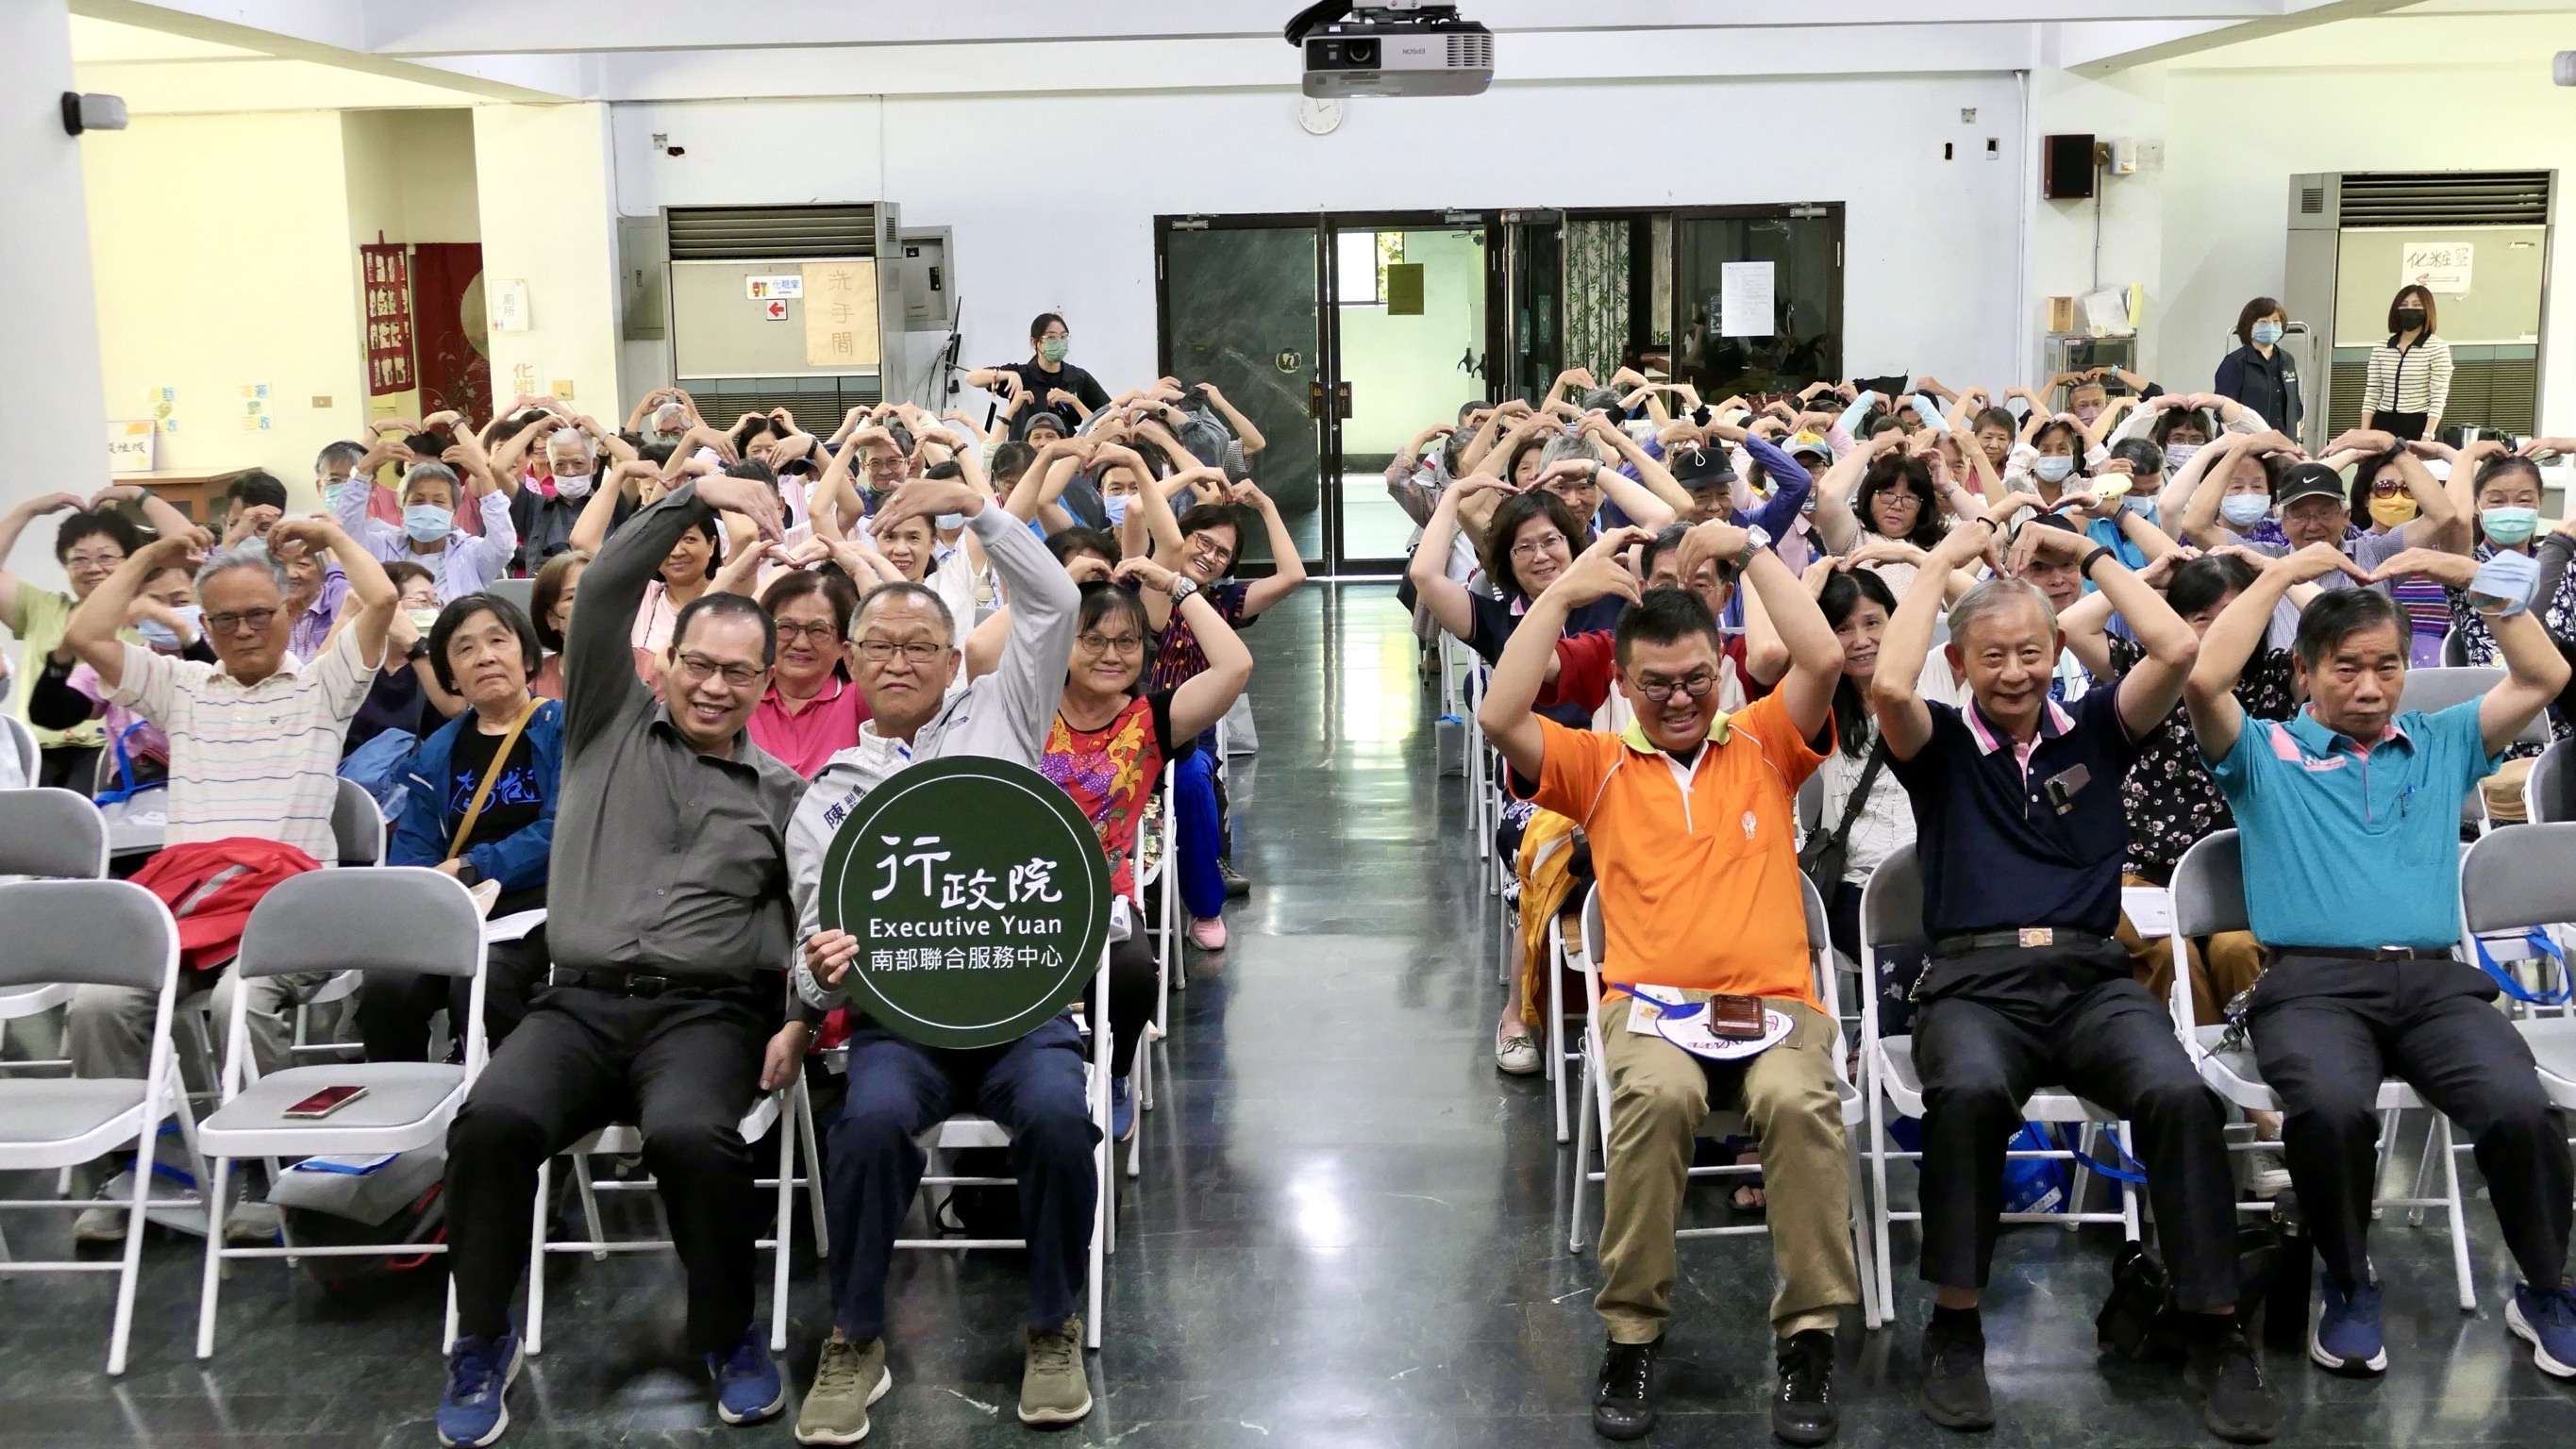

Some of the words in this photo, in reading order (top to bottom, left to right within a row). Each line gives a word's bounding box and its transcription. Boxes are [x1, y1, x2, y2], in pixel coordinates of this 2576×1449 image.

[828, 269, 855, 357] 洗手間
[823, 802, 847, 830] 陳
[872, 835, 1062, 911] 行政院
[869, 916, 991, 939] Executive
[1000, 915, 1062, 935] Yuan
[870, 944, 1063, 972] 南部聯合服務中心
